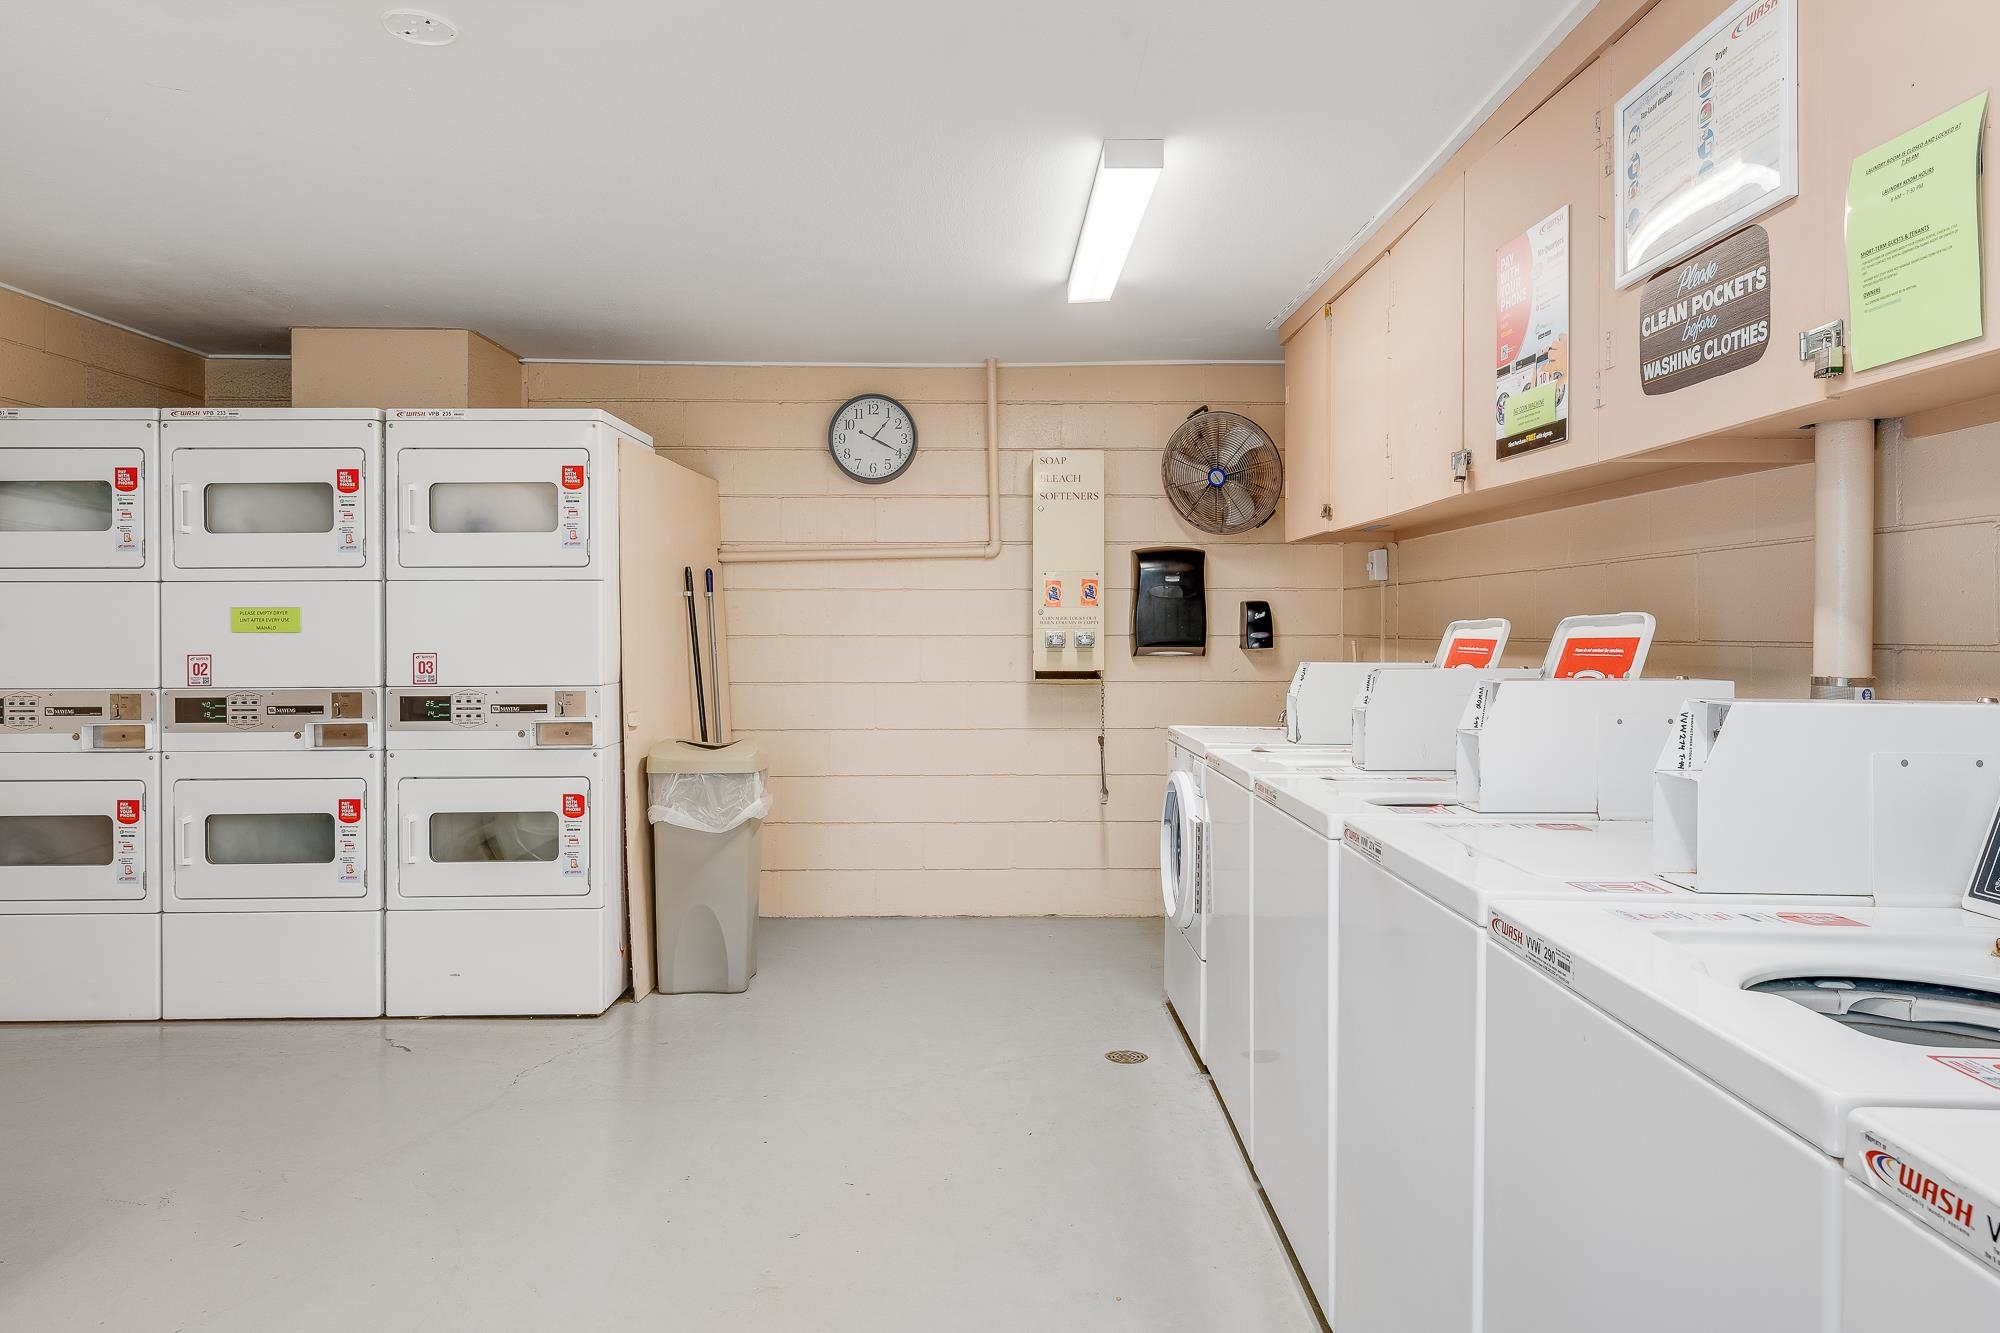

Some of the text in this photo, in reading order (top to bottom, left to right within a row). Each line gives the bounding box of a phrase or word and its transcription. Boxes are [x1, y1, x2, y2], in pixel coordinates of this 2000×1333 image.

[1715, 47, 1728, 60] Dryer
[1865, 161, 1886, 176] LAUNDRY
[1886, 154, 1901, 166] ROOM
[1906, 142, 1924, 156] CLOSED
[1925, 136, 1935, 146] AND
[1935, 126, 1954, 142] LOCKED
[1955, 122, 1962, 132] AT
[1912, 152, 1920, 162] PM
[1882, 167, 1935, 197] LAUNDRY ROOM HOURS
[1894, 193, 1902, 201] AM
[1916, 183, 1924, 191] PM
[1909, 224, 1930, 238] TENANTS
[1500, 253, 1515, 270] PAY
[1676, 261, 1719, 298] Please
[1642, 266, 1767, 337] CLEAN POCKETS
[1681, 314, 1719, 342] before
[1644, 320, 1768, 381] WASHING CLOTHES
[854, 409, 864, 420] 11
[867, 404, 879, 415] 12
[844, 419, 855, 430] 10
[894, 418, 902, 429] 2
[838, 433, 846, 444] 9
[900, 433, 908, 444] 3
[844, 448, 850, 459] 8
[896, 448, 902, 459] 4
[855, 458, 862, 470] 7
[870, 463, 876, 474] 6
[885, 459, 892, 470] 5
[1040, 492, 1099, 500] SOFTENERS
[1049, 586, 1059, 600] Tide
[1084, 585, 1095, 599] Tide
[1254, 611, 1266, 619] Scott
[193, 662, 208, 676] 02
[418, 661, 433, 674] 03
[1502, 921, 1523, 945] WASH
[1526, 934, 1541, 955] VVW
[1544, 946, 1556, 964] 290
[1899, 1162, 1973, 1228] WASH
